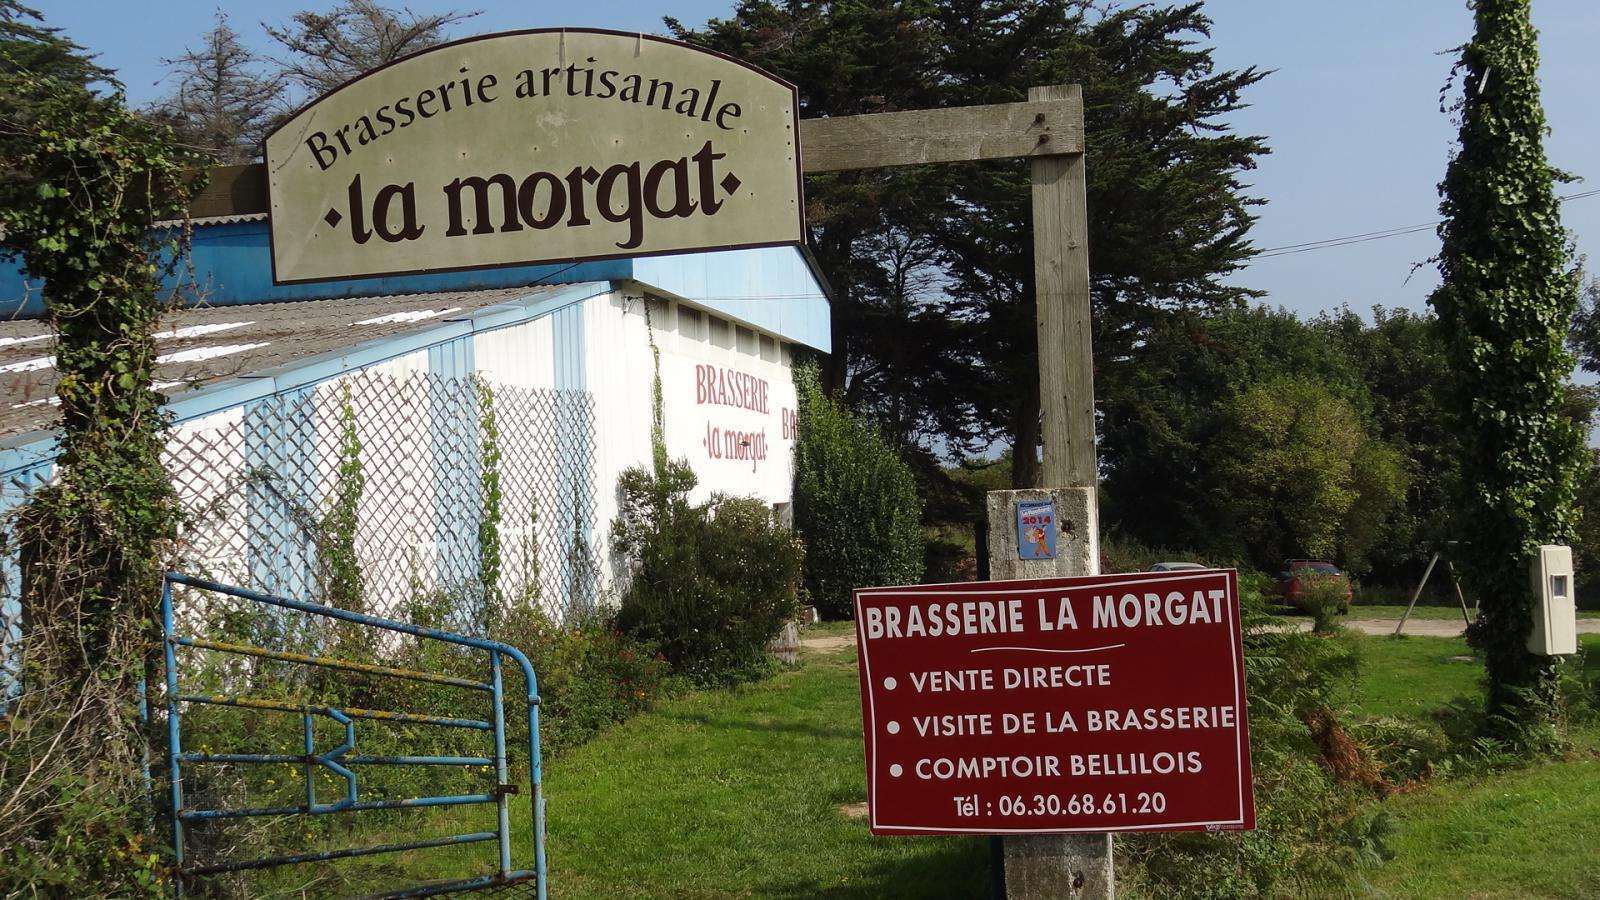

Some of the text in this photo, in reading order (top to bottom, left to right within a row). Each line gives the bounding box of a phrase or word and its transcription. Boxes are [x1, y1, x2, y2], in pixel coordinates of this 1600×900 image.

[304, 56, 742, 171] Brasserie artisanale
[347, 140, 727, 250] la morgat
[695, 364, 770, 415] BRASSERIE
[706, 419, 768, 474] la morgat
[866, 589, 1225, 639] BRASSERIE LA MORGAT
[909, 664, 1111, 693] VENTE DIRECTE
[912, 705, 1235, 737] VISITE DE LA BRASSERIE
[915, 751, 1202, 780] COMPTOIR BELLILOIS
[953, 794, 979, 817] Tél
[999, 792, 1166, 816] 06.30.68.61.20
